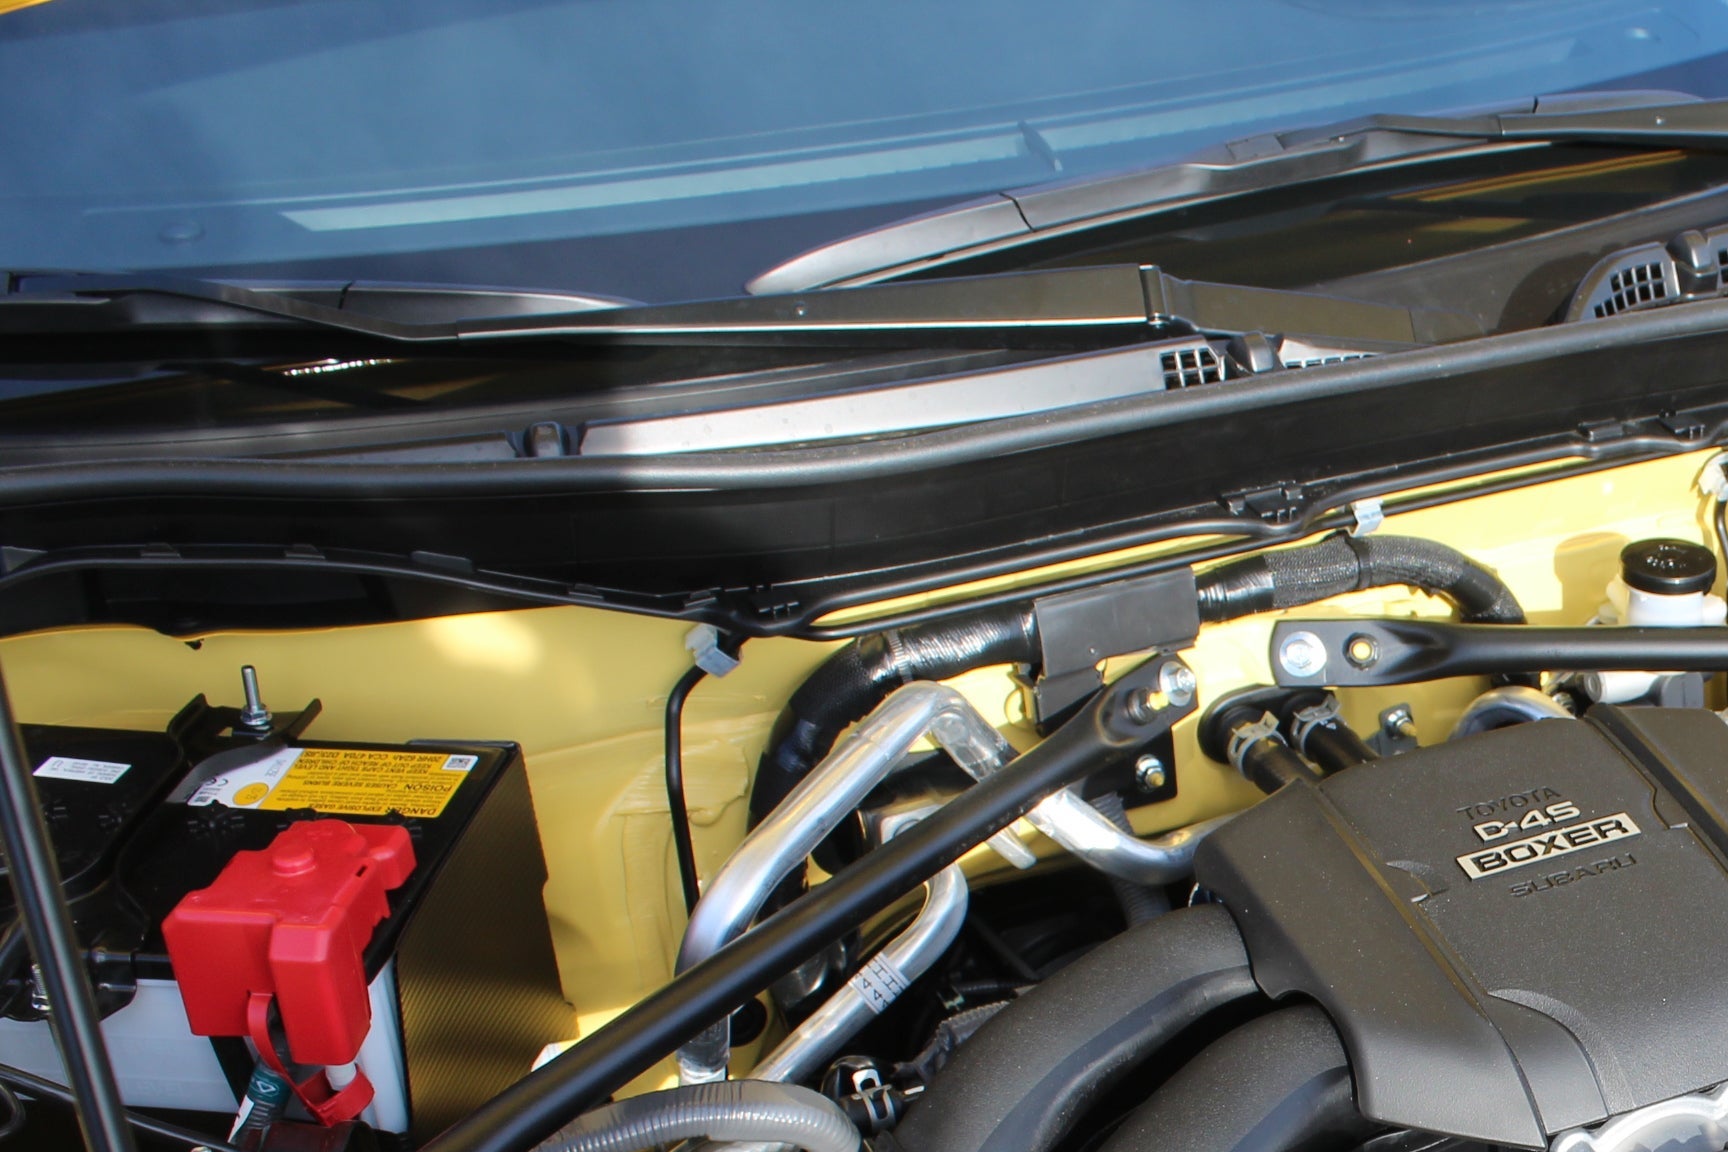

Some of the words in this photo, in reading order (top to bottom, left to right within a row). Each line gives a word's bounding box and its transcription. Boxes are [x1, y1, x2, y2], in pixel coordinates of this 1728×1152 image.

[1456, 786, 1562, 820] TOYOTA
[1473, 800, 1581, 843] D-4S
[1470, 818, 1630, 873] BOXER
[1508, 852, 1637, 898] SUBARU
